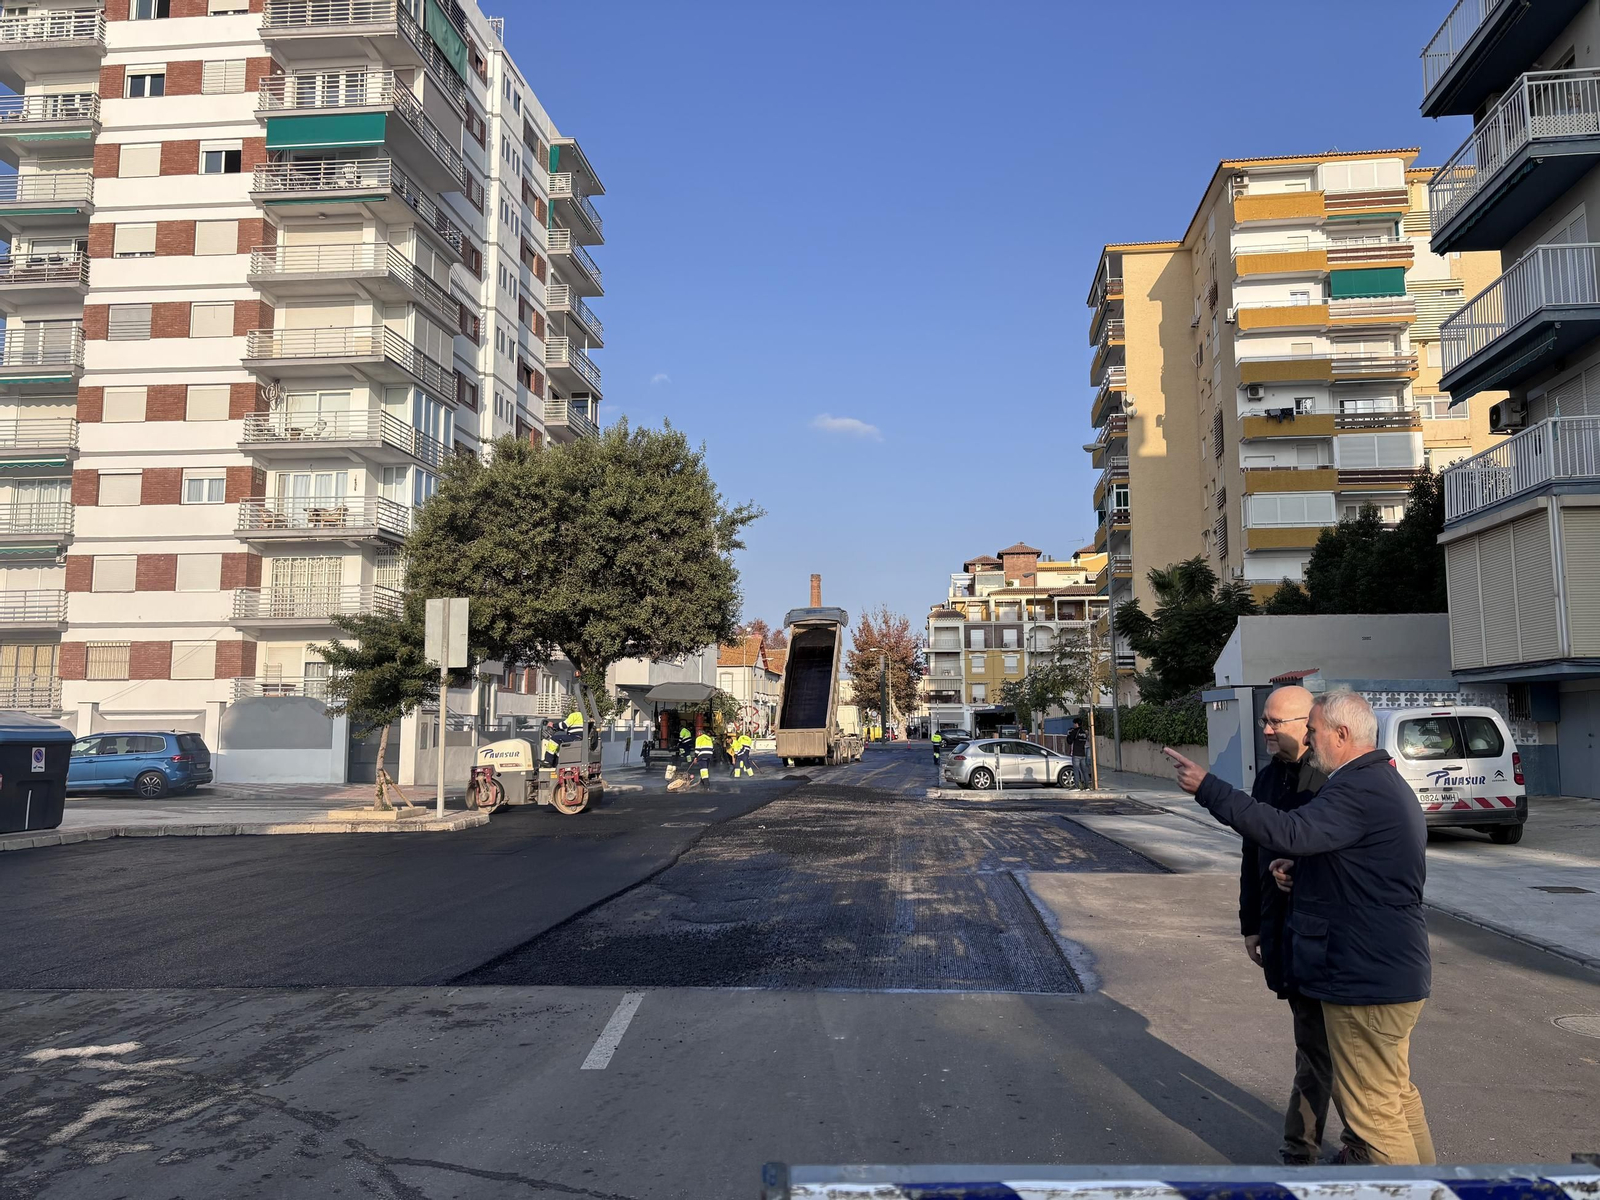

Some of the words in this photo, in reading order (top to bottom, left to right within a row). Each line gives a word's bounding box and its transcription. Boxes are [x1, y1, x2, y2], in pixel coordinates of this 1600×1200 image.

[480, 748, 520, 759] PAVASUR
[1426, 770, 1486, 787] PAVASUR
[1419, 794, 1439, 802] 0824
[1441, 794, 1456, 802] MMH
